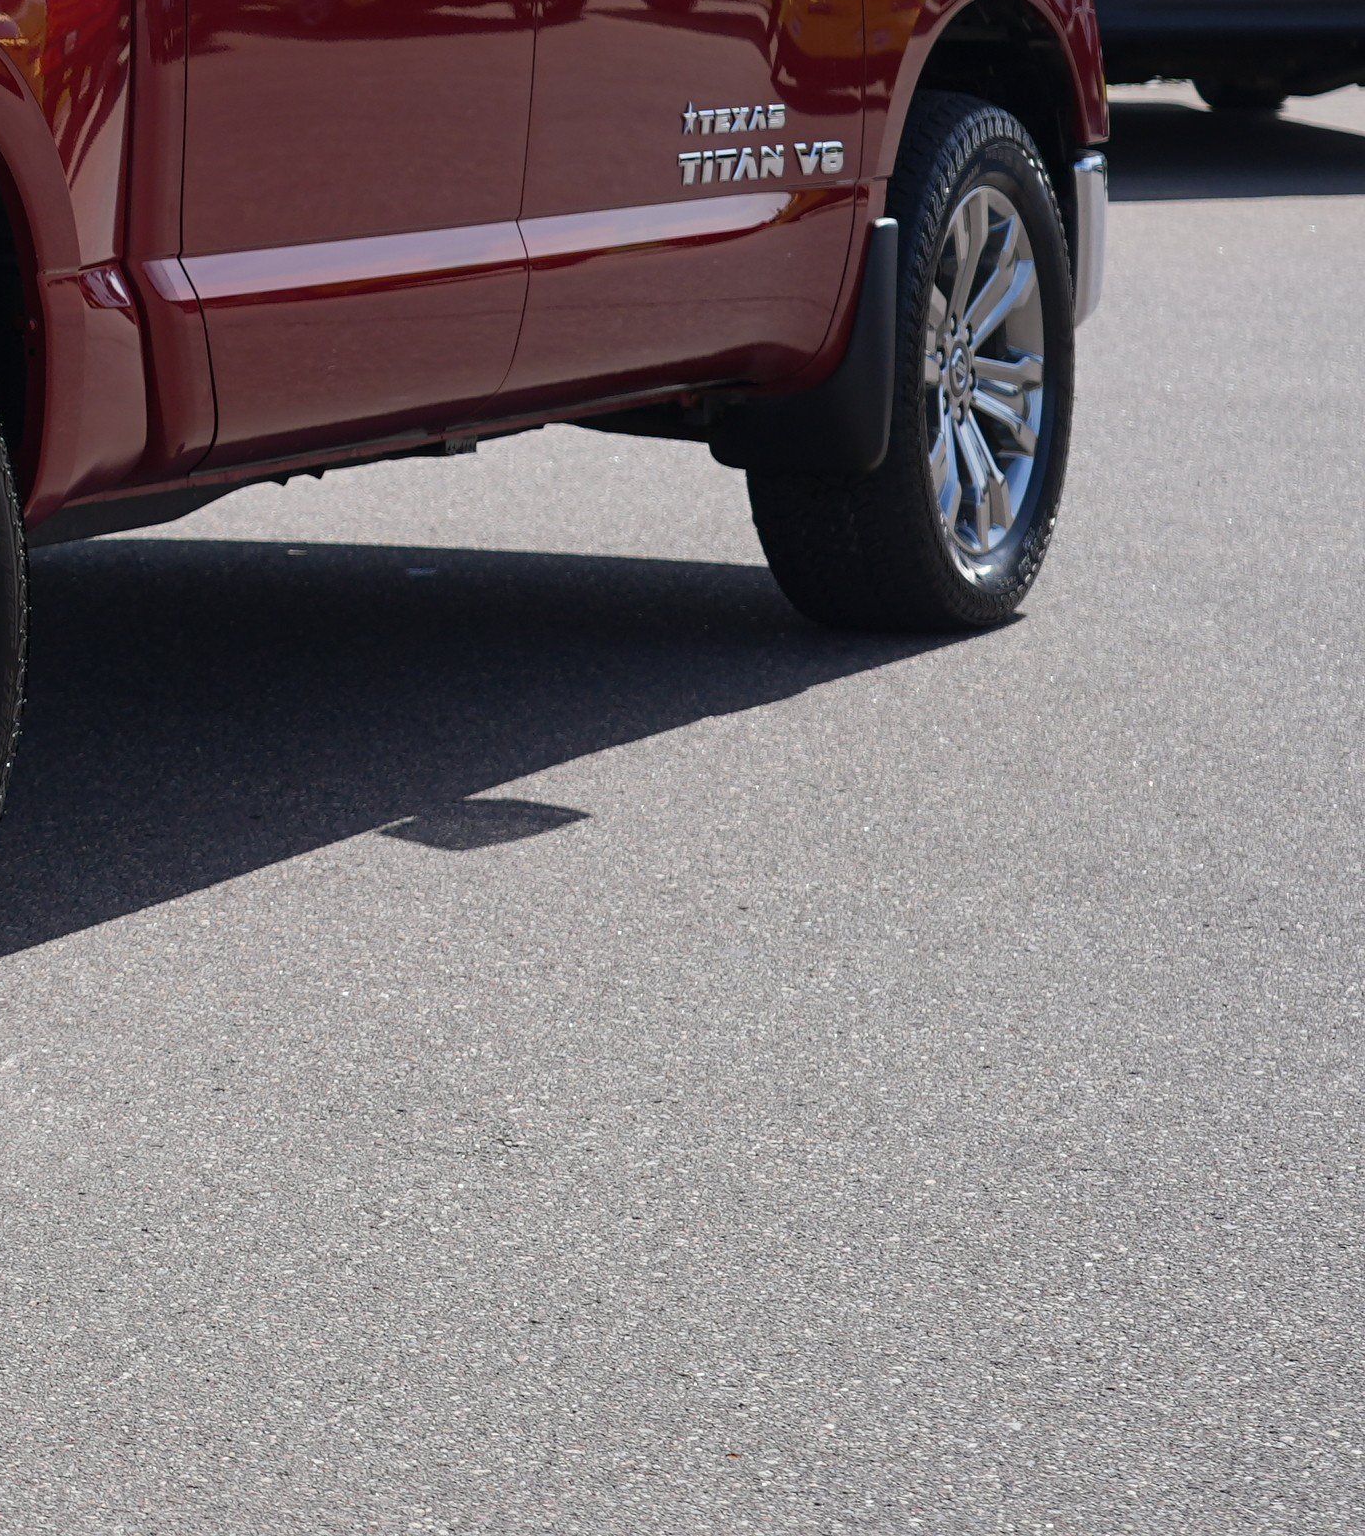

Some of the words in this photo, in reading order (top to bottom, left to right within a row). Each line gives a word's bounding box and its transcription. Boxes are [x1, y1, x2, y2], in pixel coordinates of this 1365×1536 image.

[698, 103, 786, 136] TEXAS
[679, 144, 785, 186] TITAN
[794, 140, 844, 176] V8
